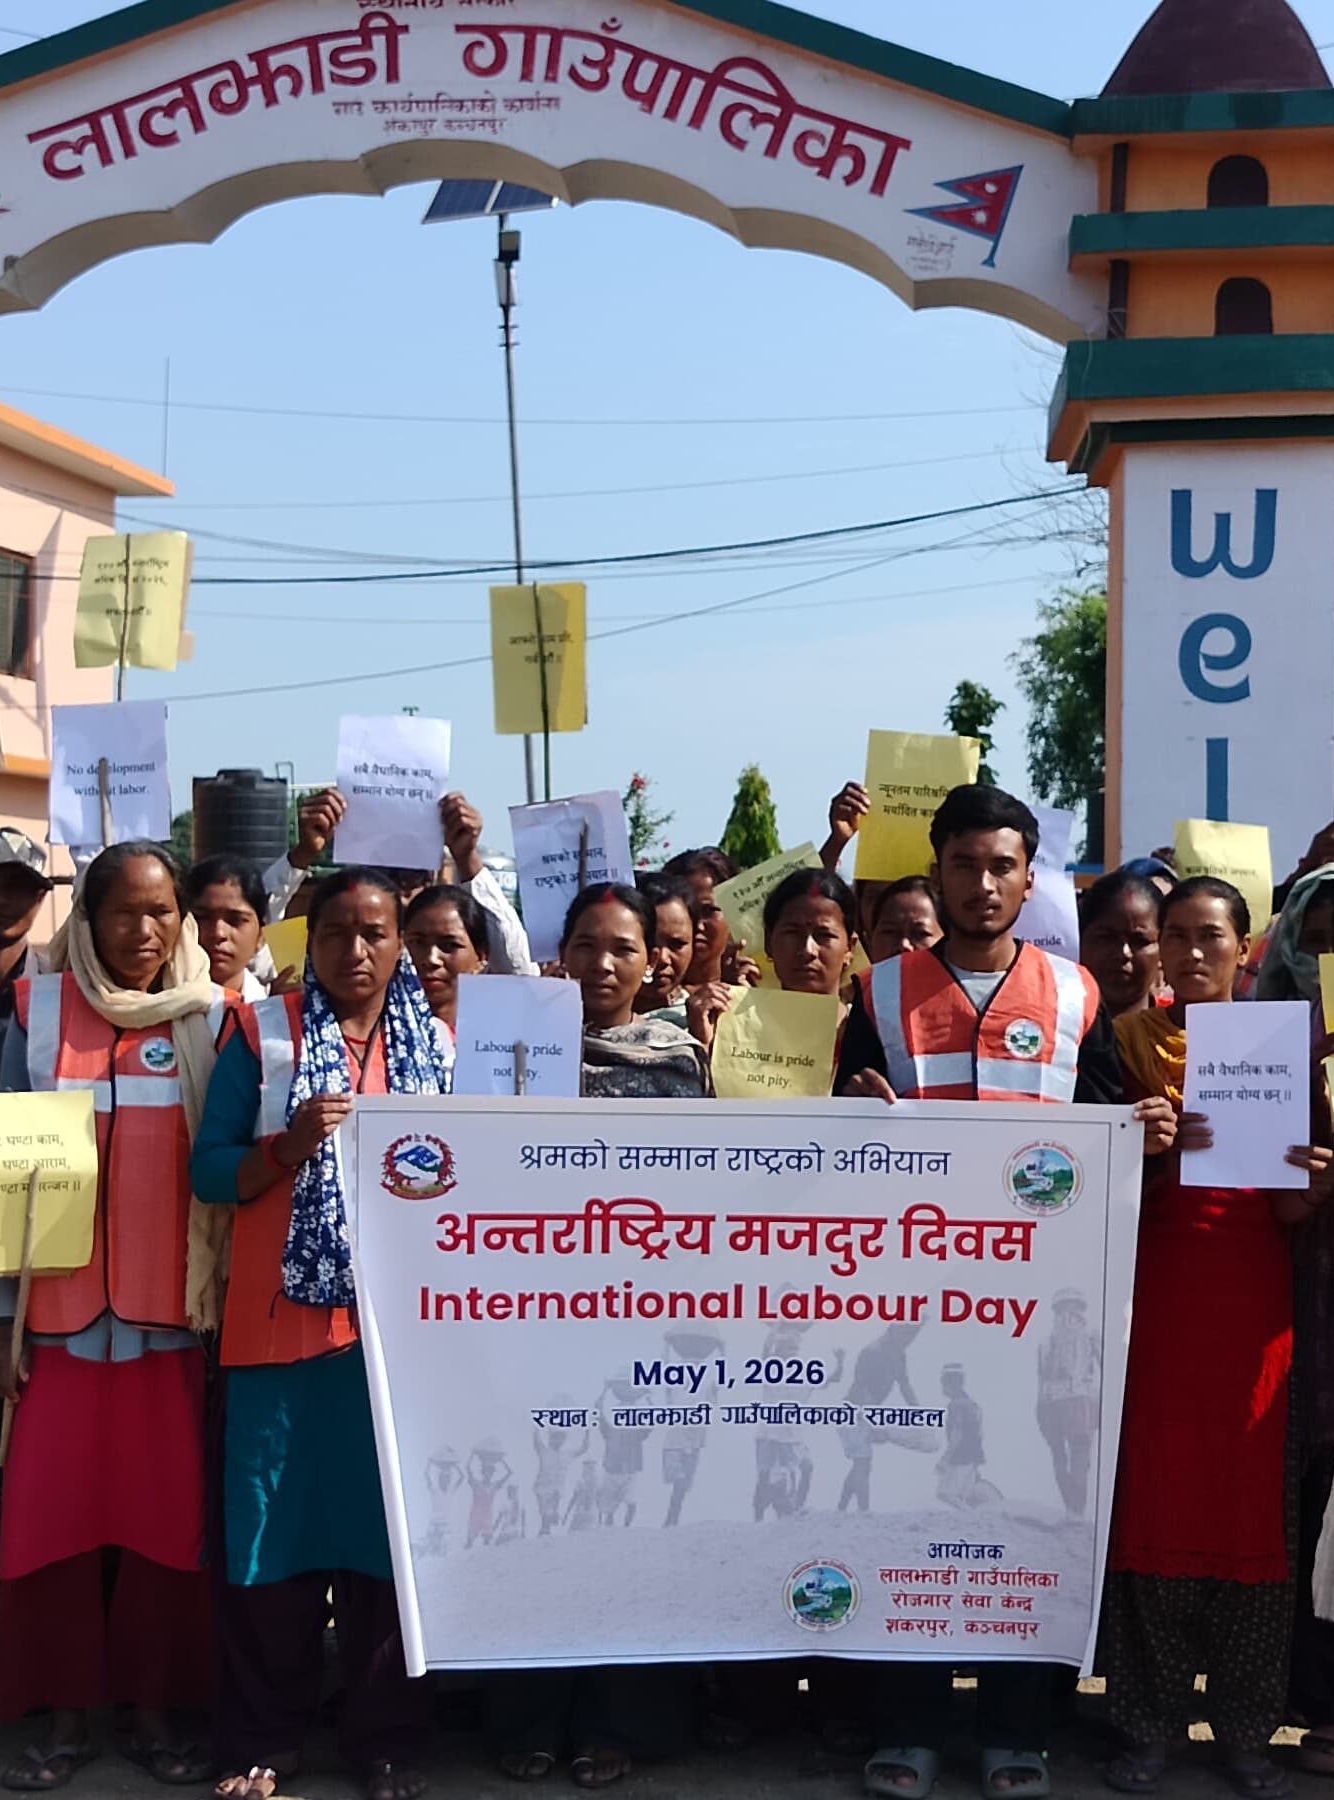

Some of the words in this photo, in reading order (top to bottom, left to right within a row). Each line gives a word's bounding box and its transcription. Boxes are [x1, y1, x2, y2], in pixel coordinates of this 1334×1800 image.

[454, 17, 911, 197] गाउँपालिका
[67, 764, 84, 775] No
[74, 785, 116, 797] withut
[119, 784, 149, 796] labor.
[532, 1043, 563, 1057] pride
[731, 1046, 771, 1062] Labour
[774, 1051, 784, 1063] is
[786, 1054, 815, 1067] pride
[493, 1066, 512, 1077] not
[1197, 1061, 1215, 1076] सबै
[1219, 1060, 1262, 1076] वैधानिक
[1265, 1064, 1291, 1078] काम,
[747, 1072, 765, 1083] not
[767, 1074, 792, 1088] pity.
[1198, 1089, 1232, 1101] सम्मान
[1236, 1085, 1260, 1101] योग्य
[6, 1135, 32, 1146] घण्टा
[36, 1134, 64, 1147] काम,
[3, 1159, 29, 1171] घण्टा
[519, 1139, 610, 1170] श्रमको
[616, 1145, 719, 1171] सम्मान
[725, 1142, 825, 1175] राष्ट्रको
[833, 1142, 952, 1176] अभियान
[435, 1198, 716, 1260] अन्तर्राष्ट्रिय
[726, 1214, 887, 1277] मजदुर
[899, 1203, 1038, 1262] दिवस
[419, 1280, 743, 1321] International
[758, 1285, 927, 1323] Labour
[940, 1288, 1037, 1338] Day
[633, 1360, 707, 1394] May
[715, 1359, 735, 1389] 1,
[744, 1359, 825, 1385] 2026
[721, 1401, 856, 1427] गाउँपालिकाको
[928, 1539, 1005, 1560] आयोजक
[967, 1563, 1059, 1588] गाउँपालिका
[891, 1589, 953, 1610] रोजगार
[961, 1590, 993, 1609] सेवा
[1000, 1591, 1035, 1612] केन्द्र
[964, 1619, 1041, 1640] कञ्चनपुर
